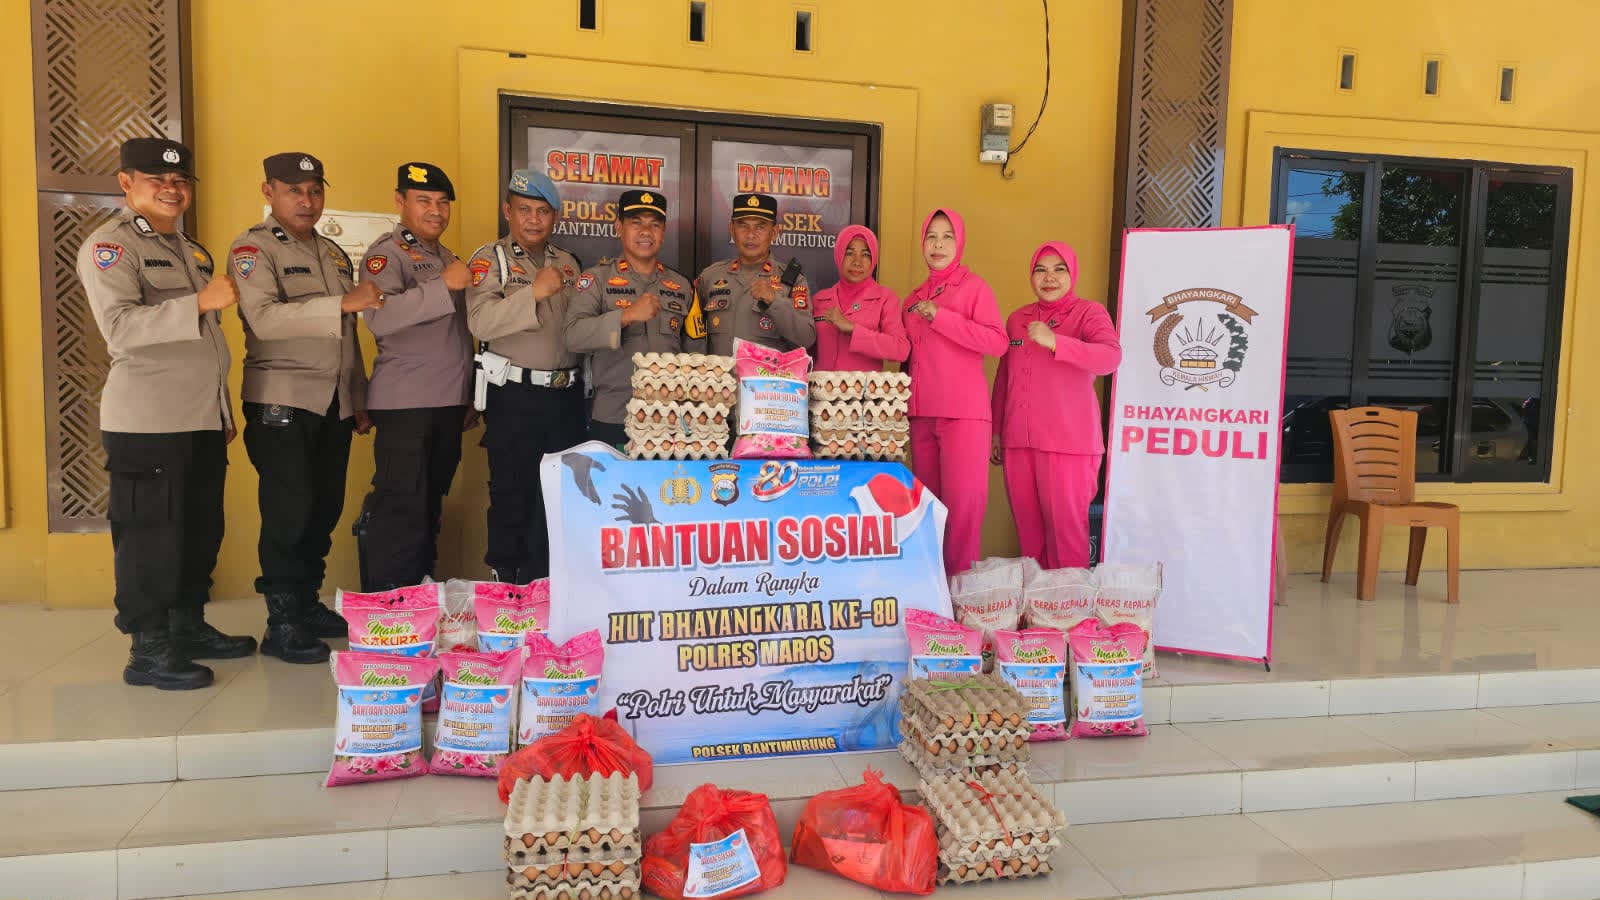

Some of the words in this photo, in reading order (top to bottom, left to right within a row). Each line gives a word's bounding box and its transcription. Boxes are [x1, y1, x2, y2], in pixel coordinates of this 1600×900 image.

[547, 151, 664, 187] SELAMAT
[737, 163, 830, 198] DATANG
[562, 200, 618, 222] POLS
[552, 221, 618, 238] ANTIMU
[779, 211, 823, 232] SEK
[606, 287, 636, 296] USMAN
[659, 289, 686, 301] POLRI
[1166, 290, 1238, 305] BHAYANGKARI
[1123, 404, 1269, 425] BHAYANGKARI
[1120, 426, 1268, 460] PEDULI
[799, 474, 841, 489] POLRI
[600, 519, 769, 569] BANTUAN
[776, 514, 900, 561] SOSIAL
[688, 575, 749, 597] Dalam
[755, 571, 820, 596] Rangka
[1033, 599, 1059, 611] BERAS
[1123, 599, 1151, 609] KEPALA
[367, 620, 413, 637] Mawar
[495, 613, 537, 632] Mawar
[607, 612, 654, 643] HUT
[659, 601, 825, 641] BHAYANGKARA
[830, 597, 898, 629] KE-80
[360, 634, 419, 647] SAKURA
[927, 639, 965, 655] Mawar
[678, 642, 756, 672] POLRES
[760, 636, 834, 666] MAROS
[1012, 645, 1049, 659] Mawar
[1092, 646, 1129, 660] Mawar
[361, 670, 409, 687] Mawar
[689, 683, 759, 716] Untuk
[692, 744, 742, 759] POLSEK
[743, 736, 838, 757] BANTIMURUNG
